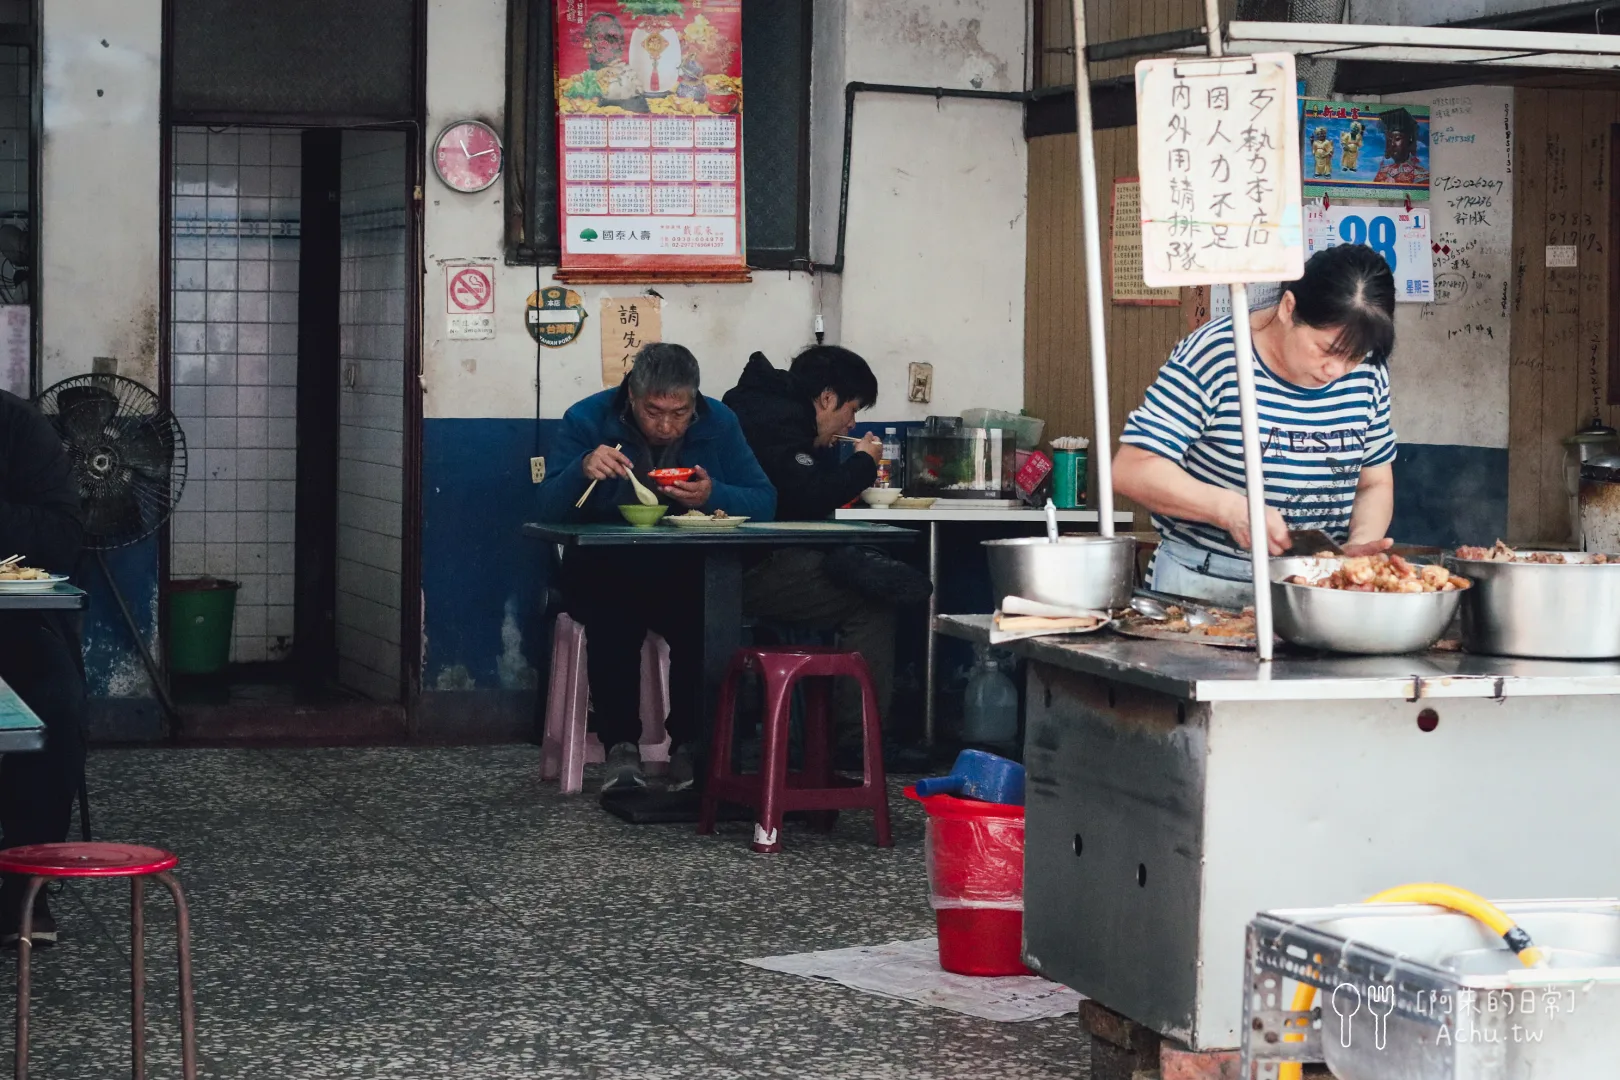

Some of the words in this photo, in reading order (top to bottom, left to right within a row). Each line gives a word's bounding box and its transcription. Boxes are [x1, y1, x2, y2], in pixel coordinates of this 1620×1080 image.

[1202, 86, 1238, 249] 因人力不足
[602, 230, 651, 241] 國泰人壽
[1406, 280, 1430, 294] 星期三
[547, 299, 561, 307] 本店
[618, 304, 641, 376] 請先付
